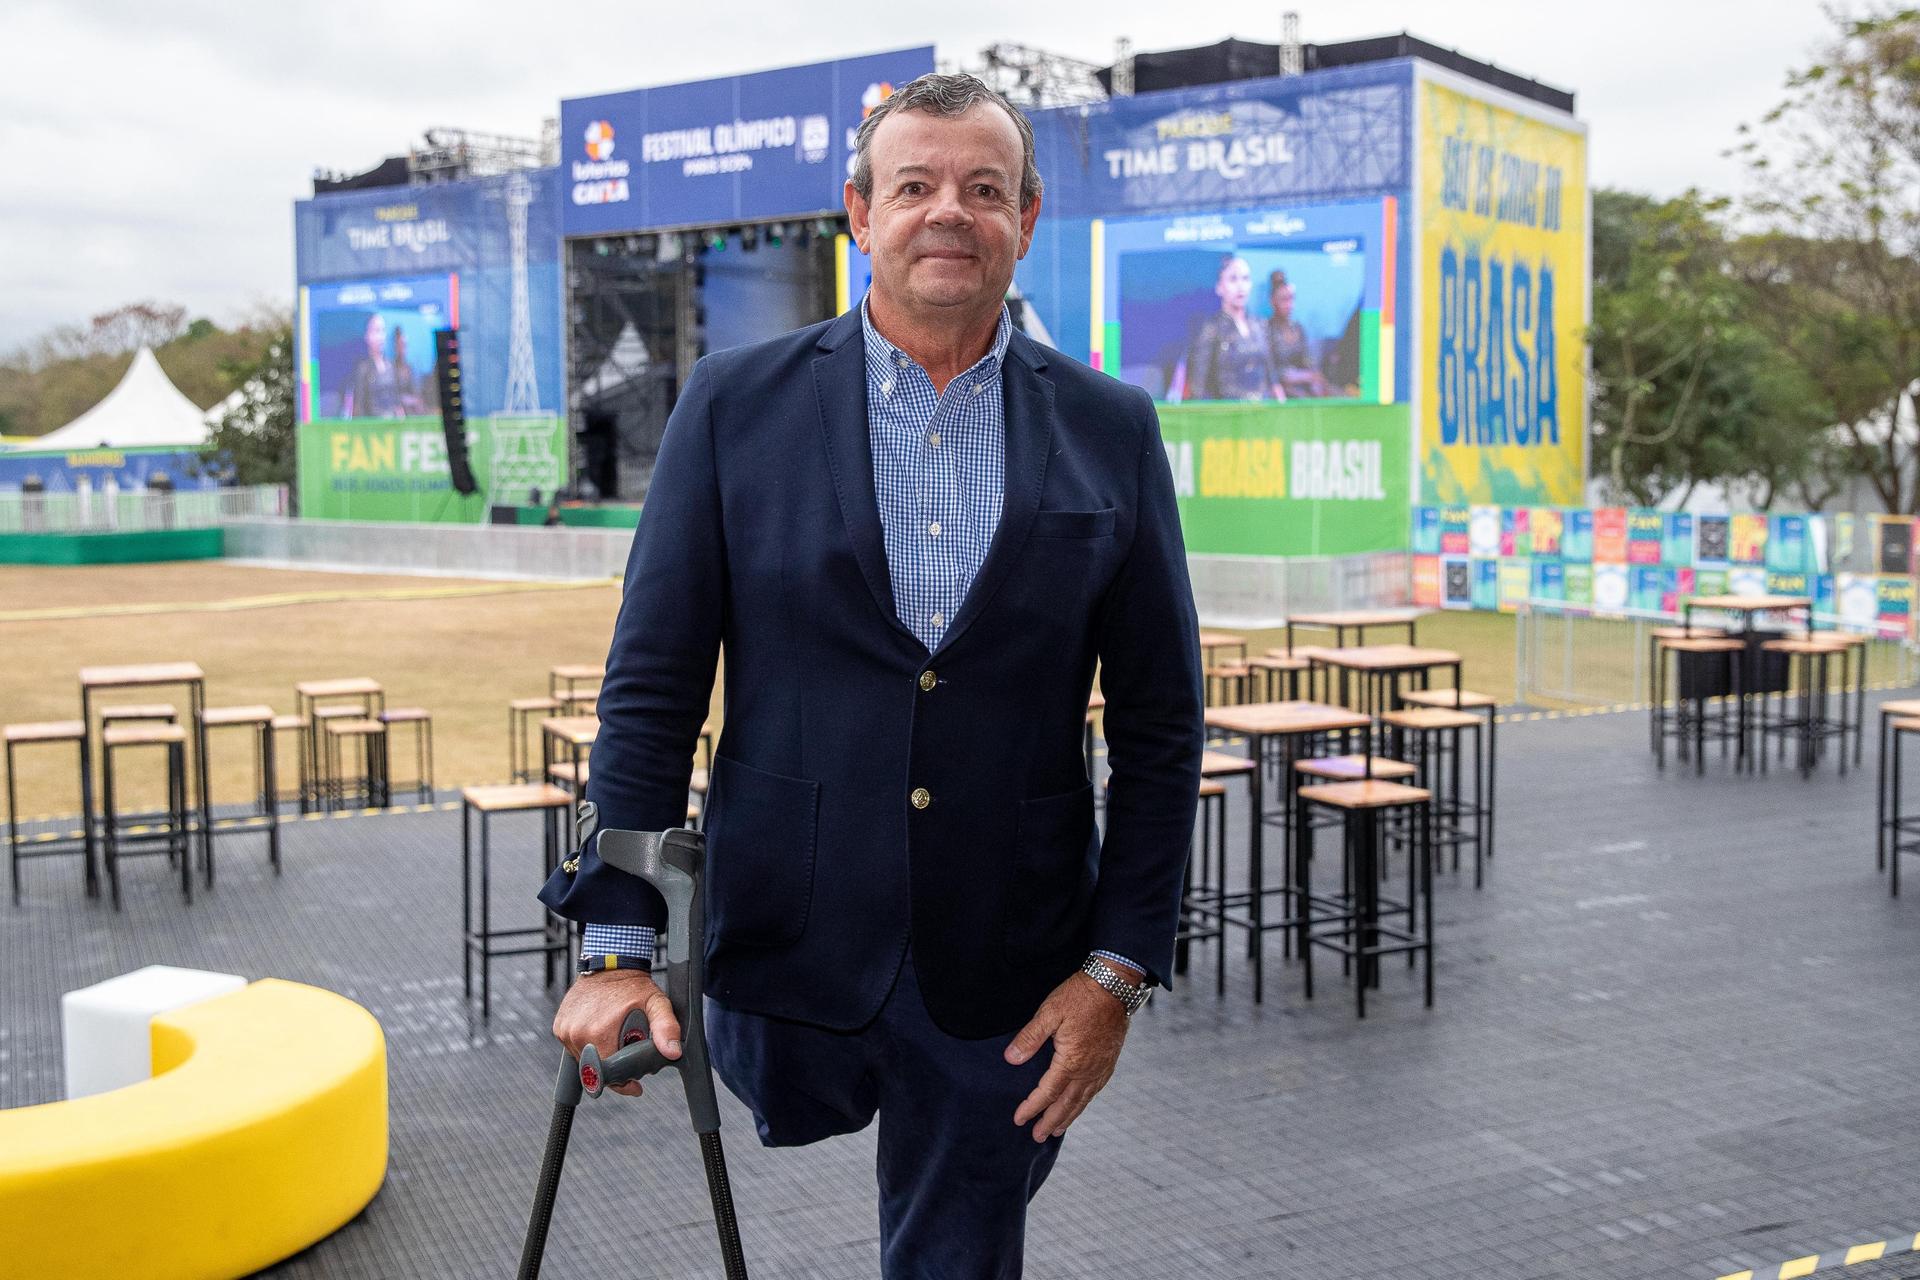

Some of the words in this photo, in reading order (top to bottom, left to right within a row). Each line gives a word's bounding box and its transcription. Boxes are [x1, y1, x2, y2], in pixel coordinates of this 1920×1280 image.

[643, 127, 713, 162] FESTIVAL
[714, 115, 796, 155] OLÍMPICO
[1104, 144, 1178, 178] TIME
[1187, 132, 1294, 179] BRASIL
[347, 224, 390, 249] TIME
[392, 219, 450, 252] BRASIL
[1439, 241, 1559, 445] BRASA
[331, 431, 396, 473] FAN
[1202, 438, 1286, 498] BRASA
[1291, 440, 1386, 500] BRASIL
